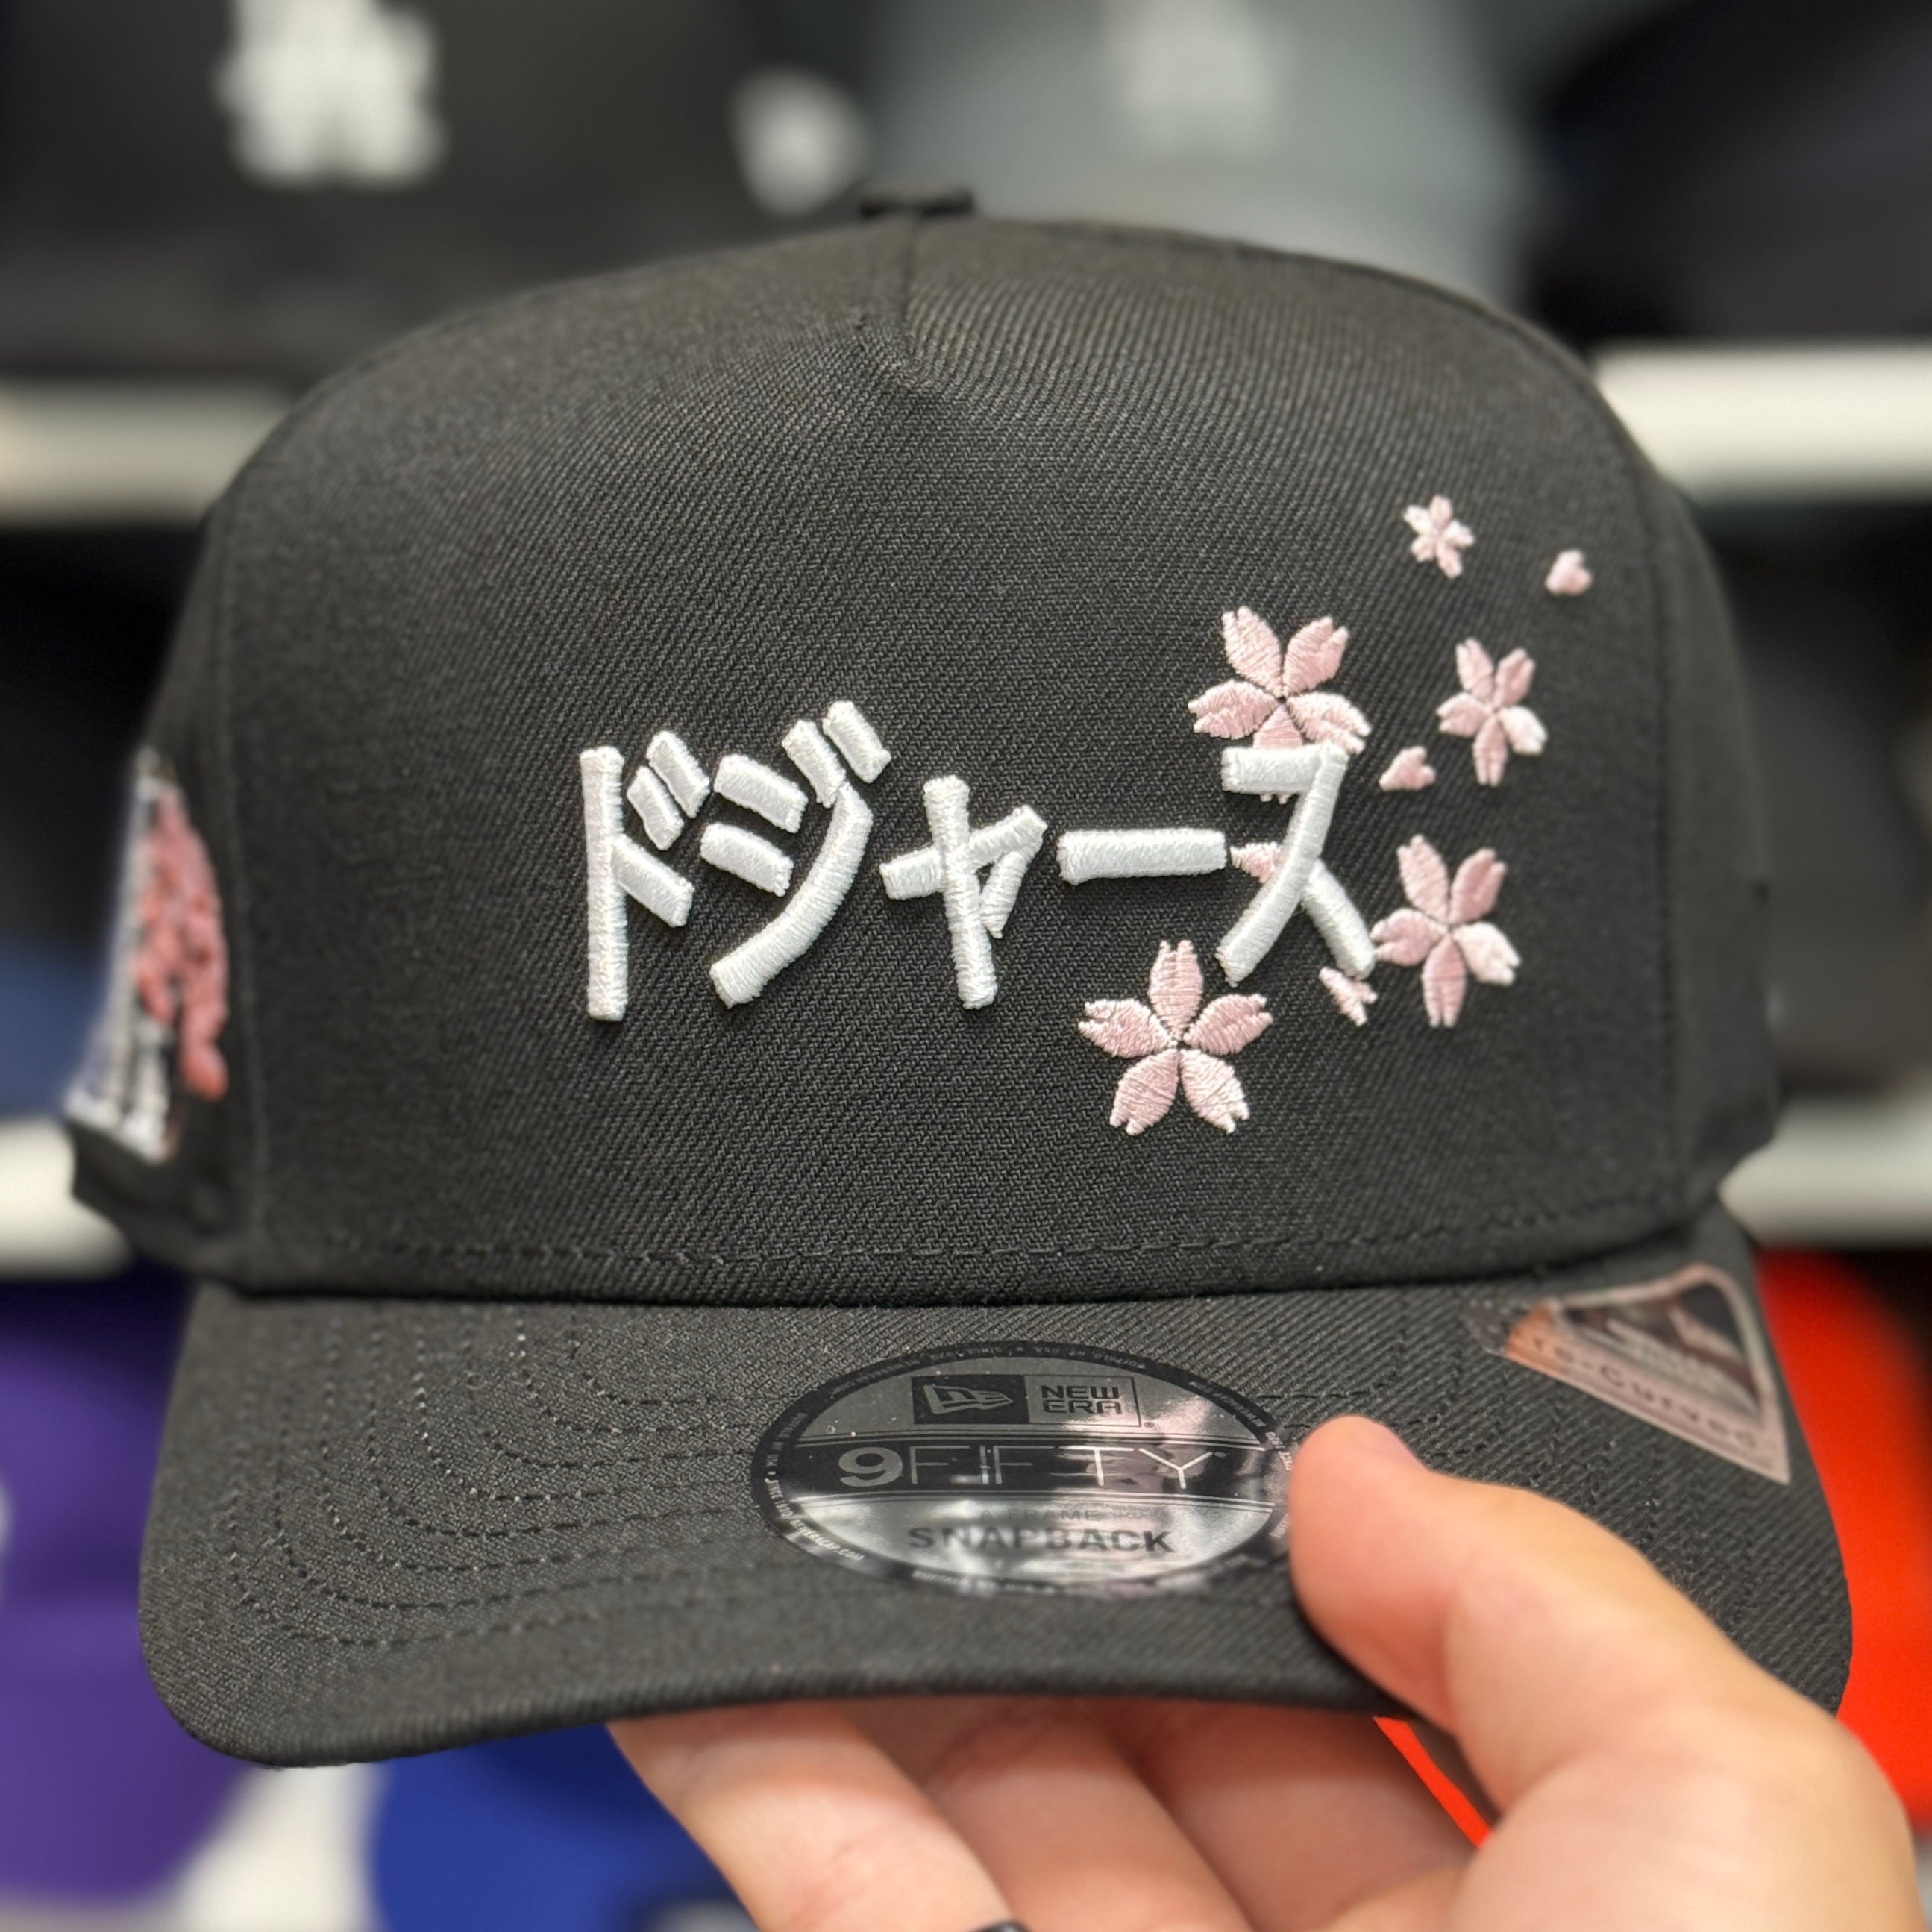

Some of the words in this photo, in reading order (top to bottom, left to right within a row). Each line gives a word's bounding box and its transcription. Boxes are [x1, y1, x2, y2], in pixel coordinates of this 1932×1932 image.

[580, 699, 1377, 1023] ドジャース
[1040, 1384, 1119, 1400] NEW
[1044, 1399, 1123, 1415] ERA
[838, 1445, 1215, 1490] 9FIFTY
[907, 1526, 1175, 1553] SNAPBACK
